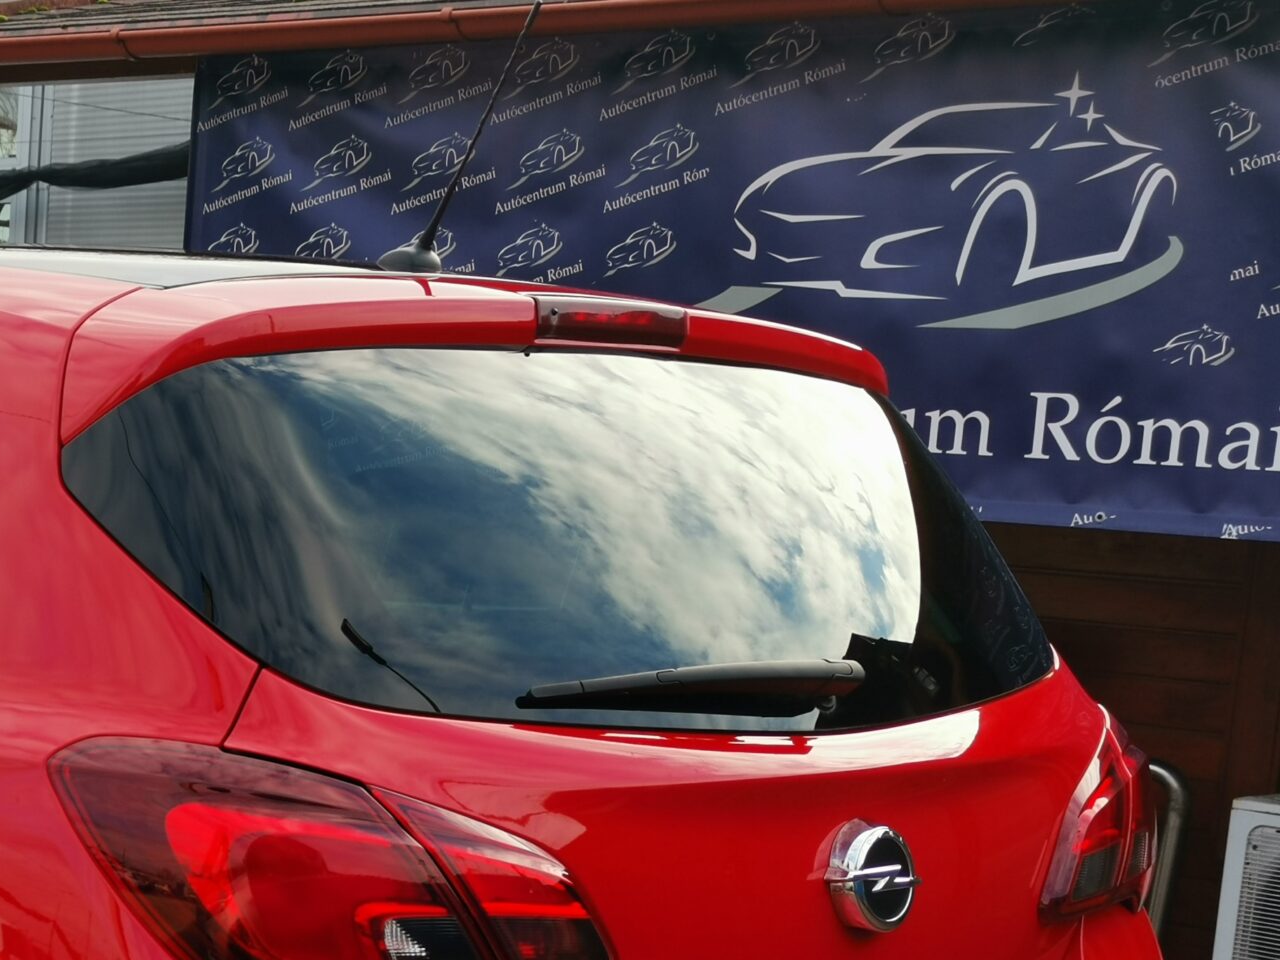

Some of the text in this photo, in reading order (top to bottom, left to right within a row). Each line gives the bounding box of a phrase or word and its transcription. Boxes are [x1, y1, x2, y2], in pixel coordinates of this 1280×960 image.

[599, 64, 718, 121] Autócentrum Római
[714, 59, 847, 116] Autócentrum Római
[1155, 55, 1230, 88] ócentrum
[196, 86, 289, 134] Autócentrum Római
[288, 82, 388, 132] Autócentrum Római
[384, 77, 493, 129] Autócentrum Római
[490, 71, 602, 126] Autócentrum Római
[202, 168, 293, 216] Autócentrum Római
[289, 168, 393, 215] Autócentrum Római
[390, 166, 497, 216] Autócentru Római
[494, 163, 607, 215] Autócentrum Római
[603, 176, 680, 214] Autócentrum
[546, 259, 584, 285] Római
[1230, 260, 1260, 282] mai
